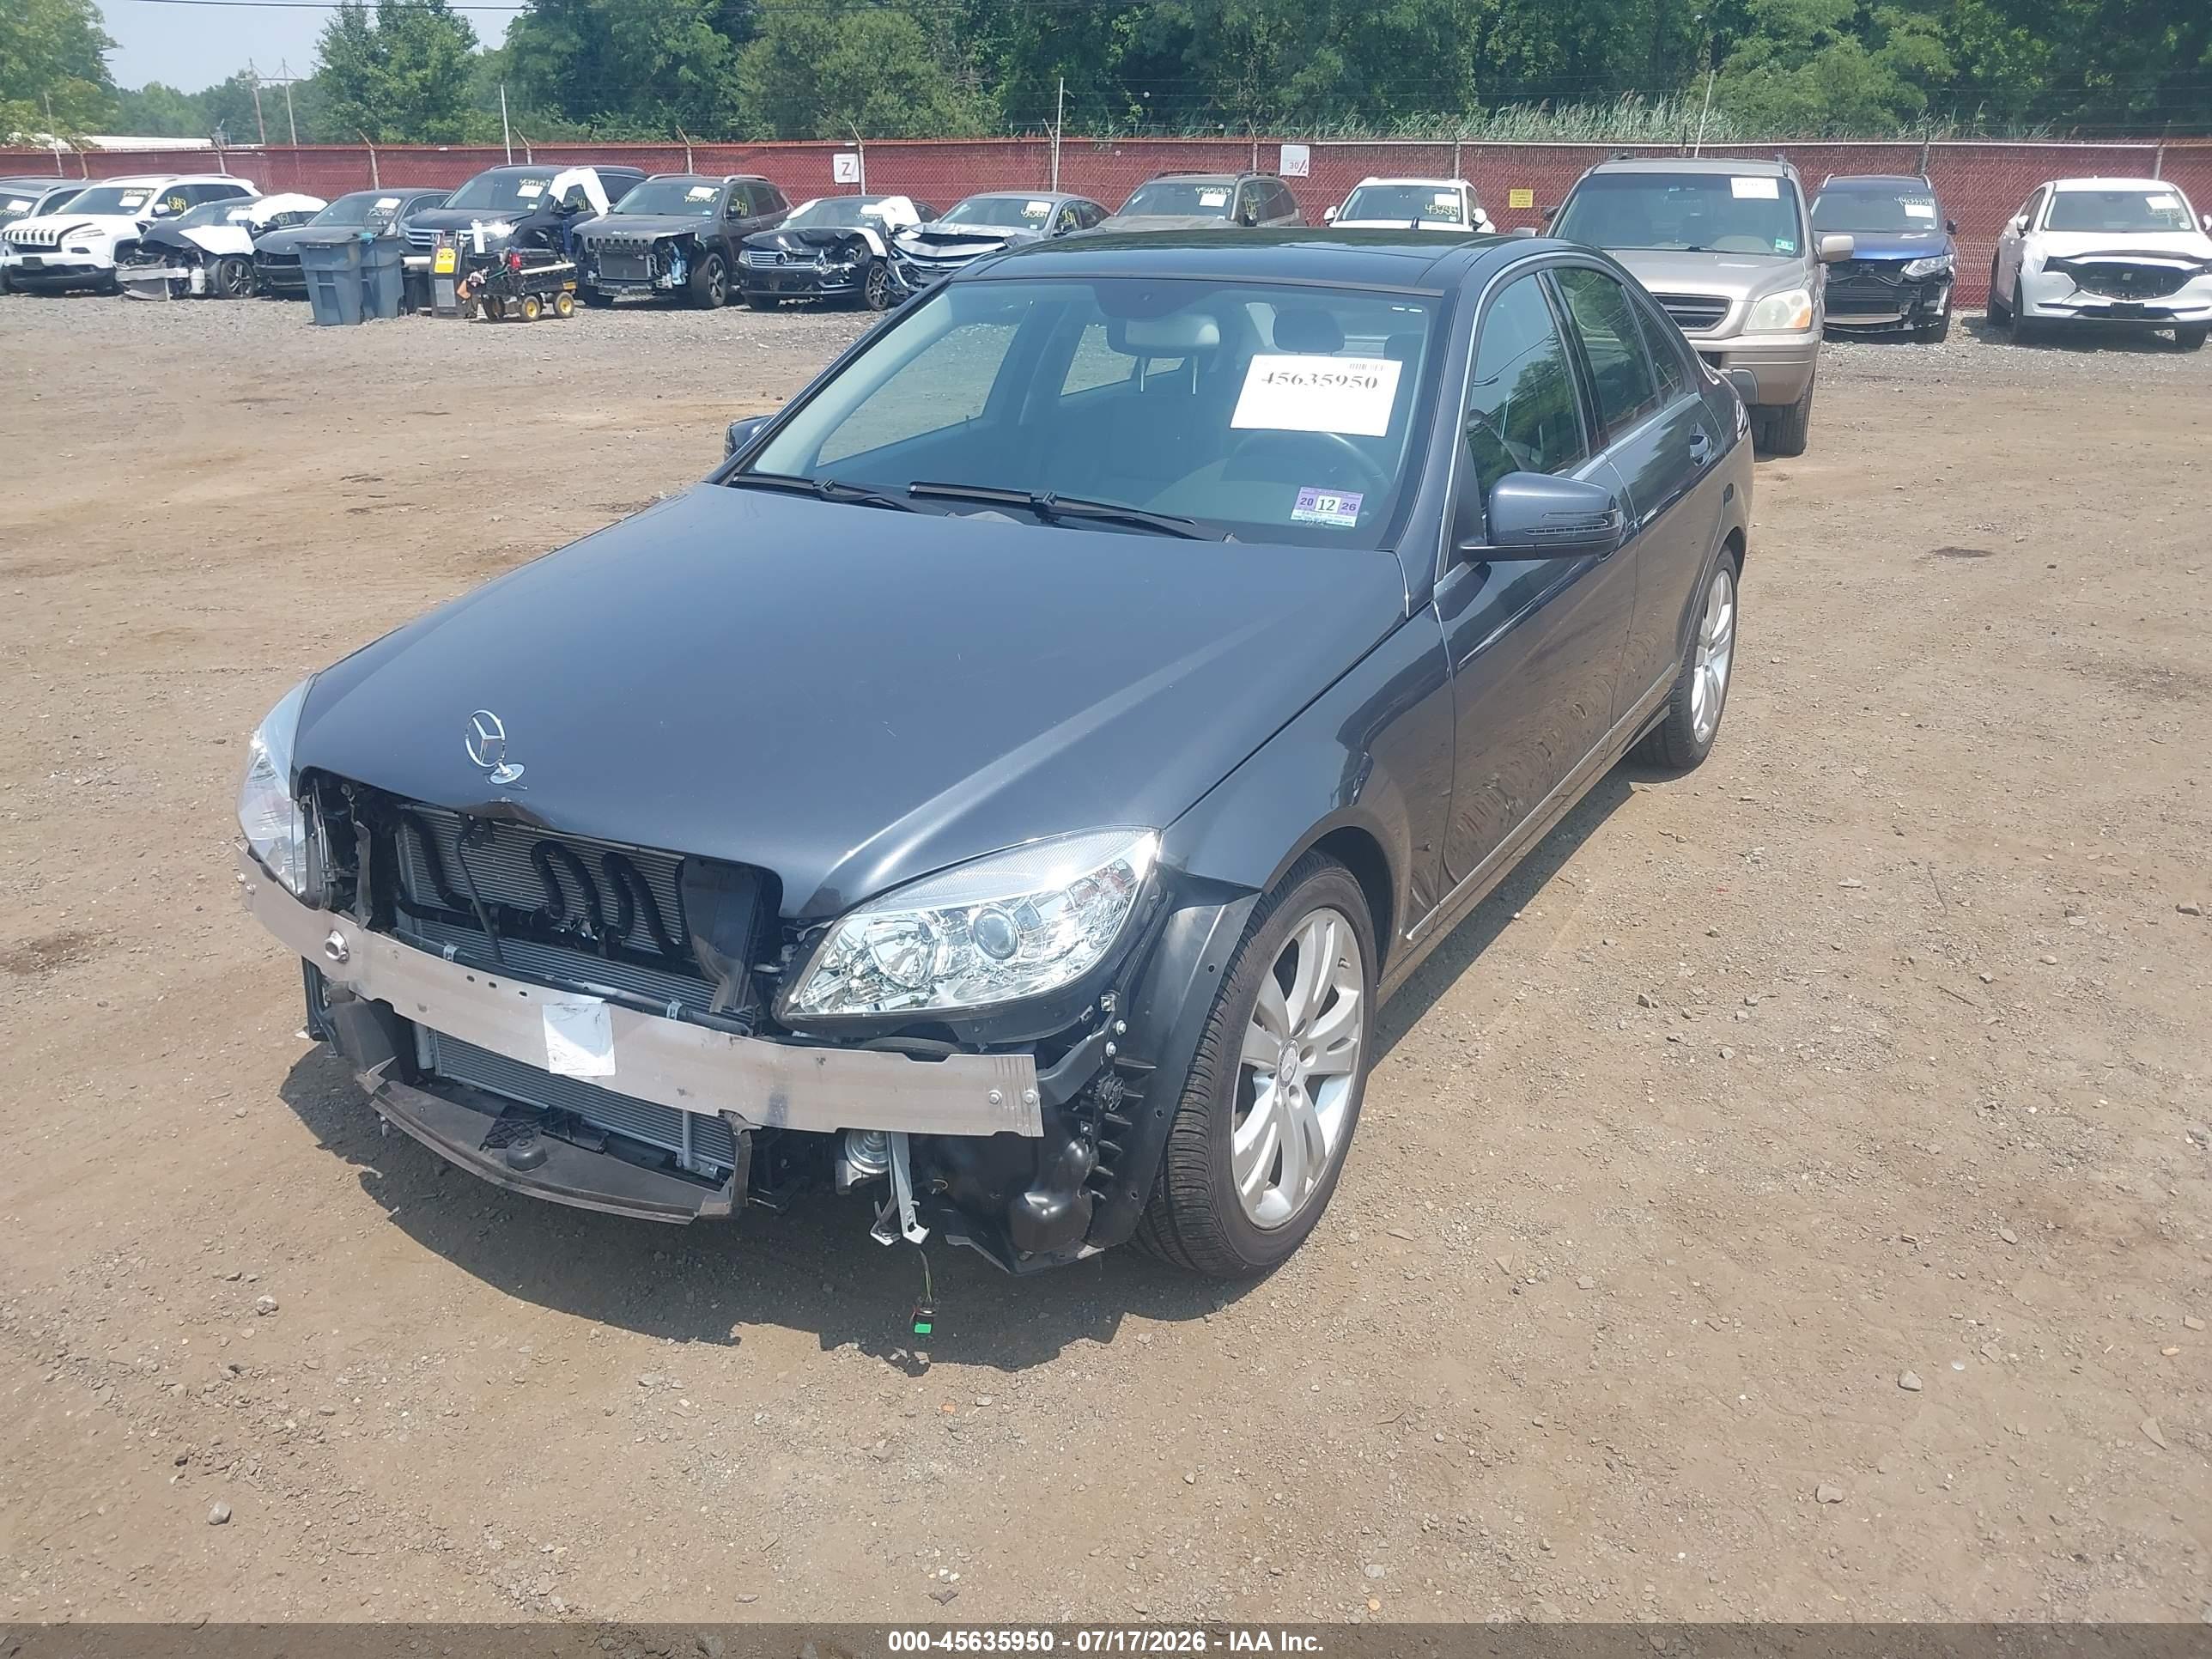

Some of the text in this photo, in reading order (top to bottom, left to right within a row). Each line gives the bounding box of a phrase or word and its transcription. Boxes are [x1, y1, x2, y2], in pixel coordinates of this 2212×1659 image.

[842, 161, 852, 176] Z
[1289, 161, 1299, 170] 30
[1261, 372, 1378, 389] 45635950
[1300, 497, 1357, 511] 20 12 26
